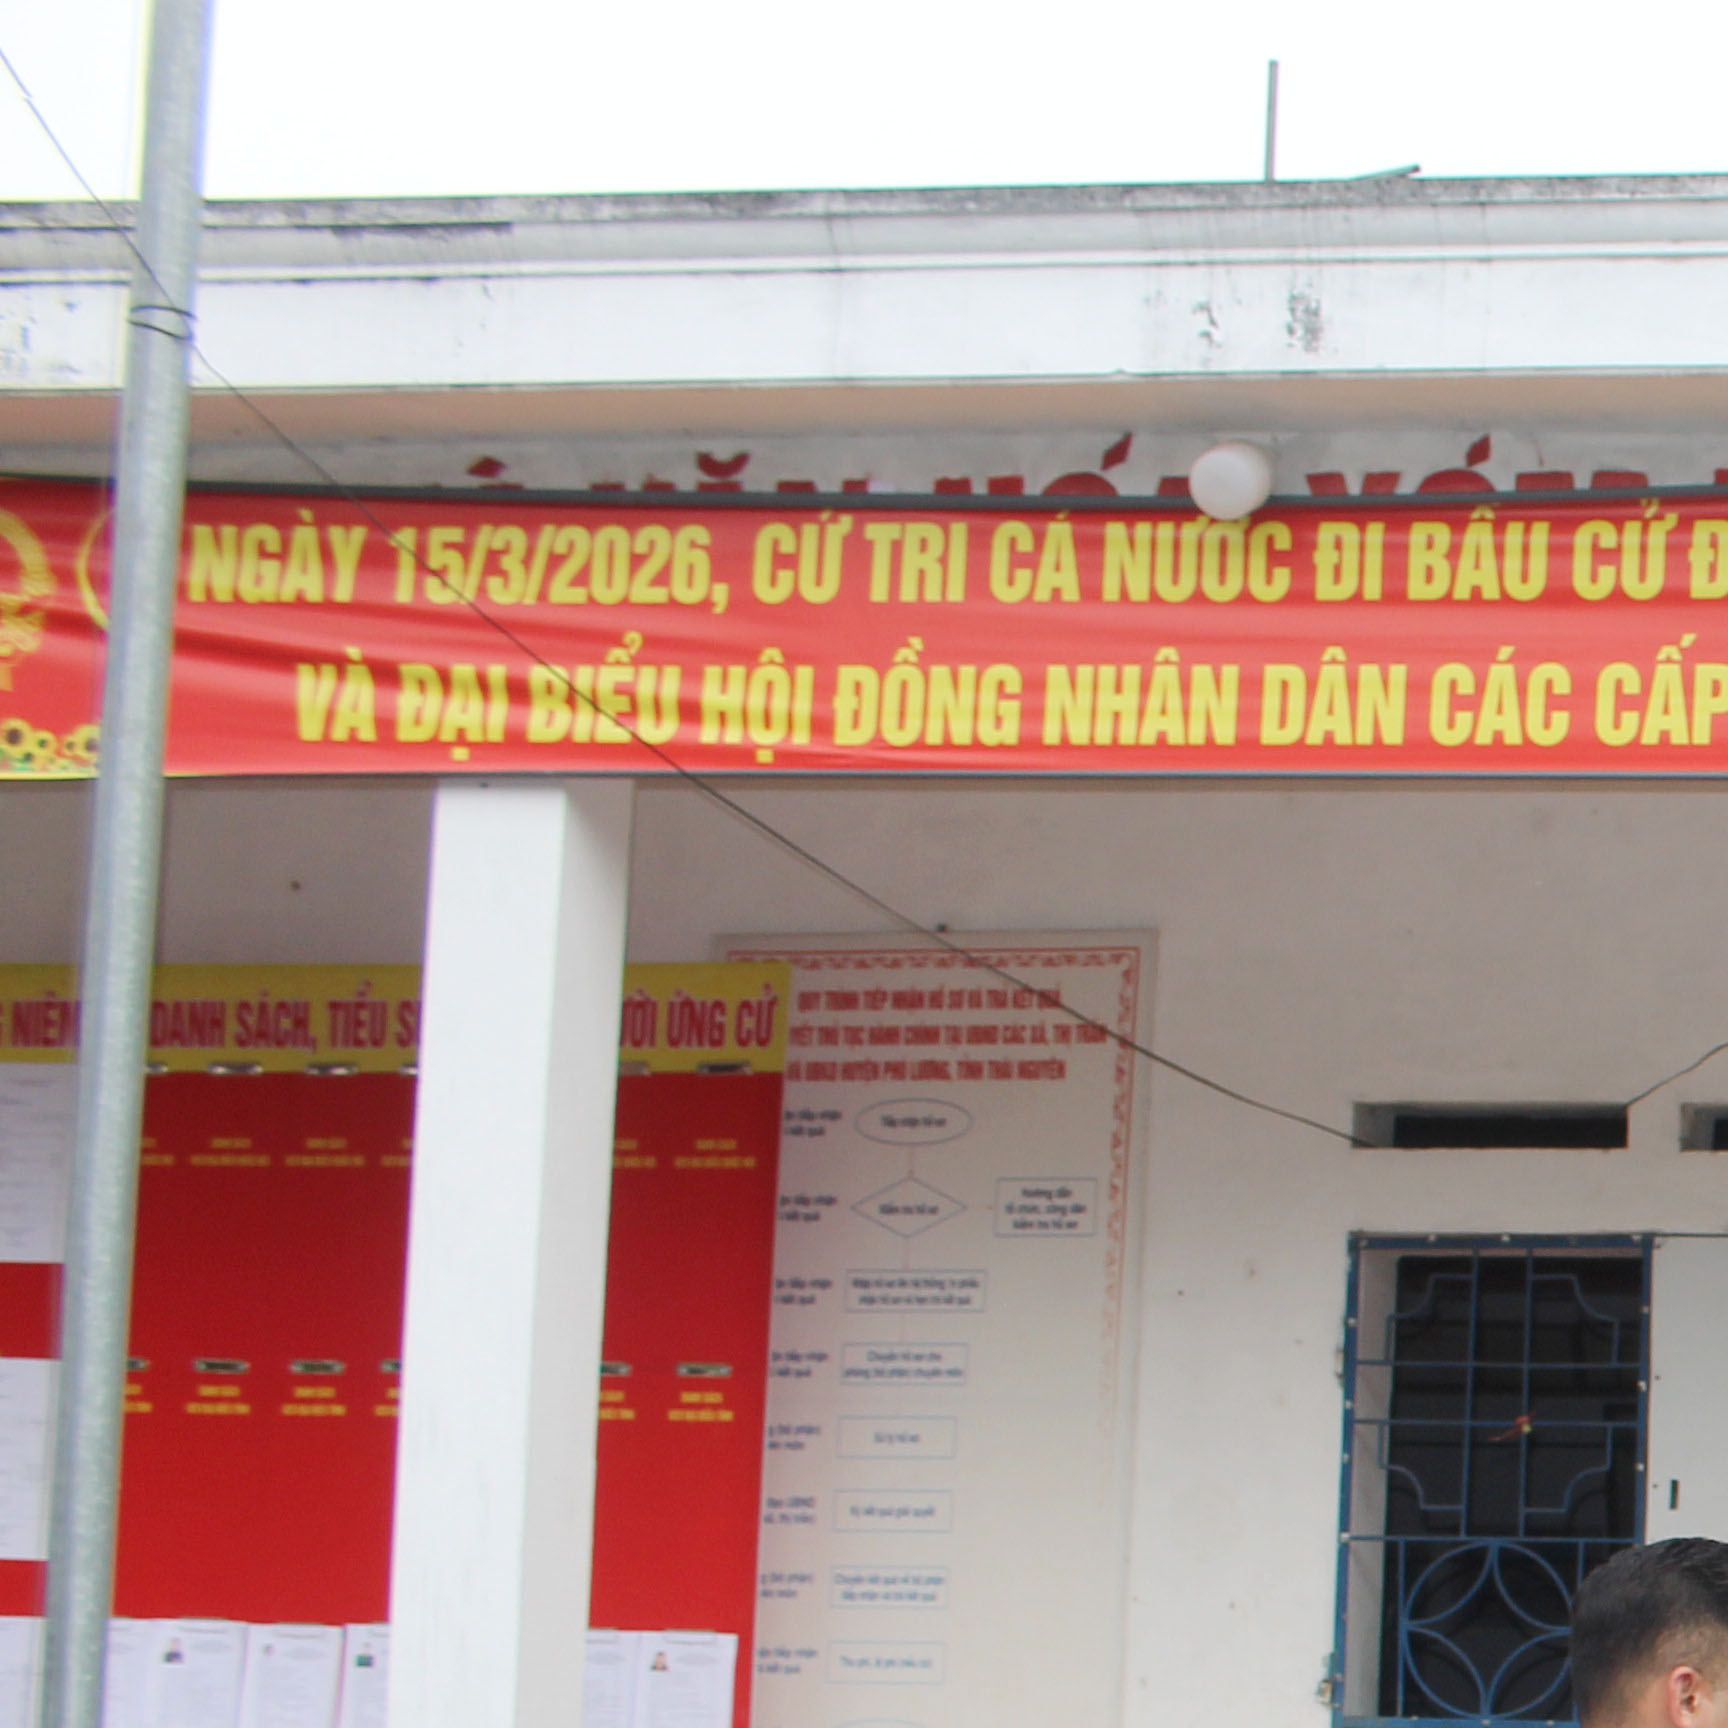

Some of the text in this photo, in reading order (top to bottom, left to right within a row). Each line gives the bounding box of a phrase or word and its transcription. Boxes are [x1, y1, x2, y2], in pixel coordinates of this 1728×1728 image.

[186, 508, 368, 602] NGÀY
[388, 522, 729, 614] 15/3/2026,
[864, 521, 968, 602] TRI
[1314, 521, 1385, 600] ĐI
[1571, 498, 1679, 601] CỬ
[296, 646, 378, 742] VÀ
[399, 663, 507, 761] ĐẠI
[525, 631, 682, 744] BIỂU
[700, 647, 814, 763] HỘI
[833, 636, 1023, 746] ĐỒNG
[1042, 646, 1239, 746] NHÂN
[1260, 646, 1406, 746] DÂN
[1428, 646, 1573, 746] CÁC
[150, 1000, 228, 1048] DANH
